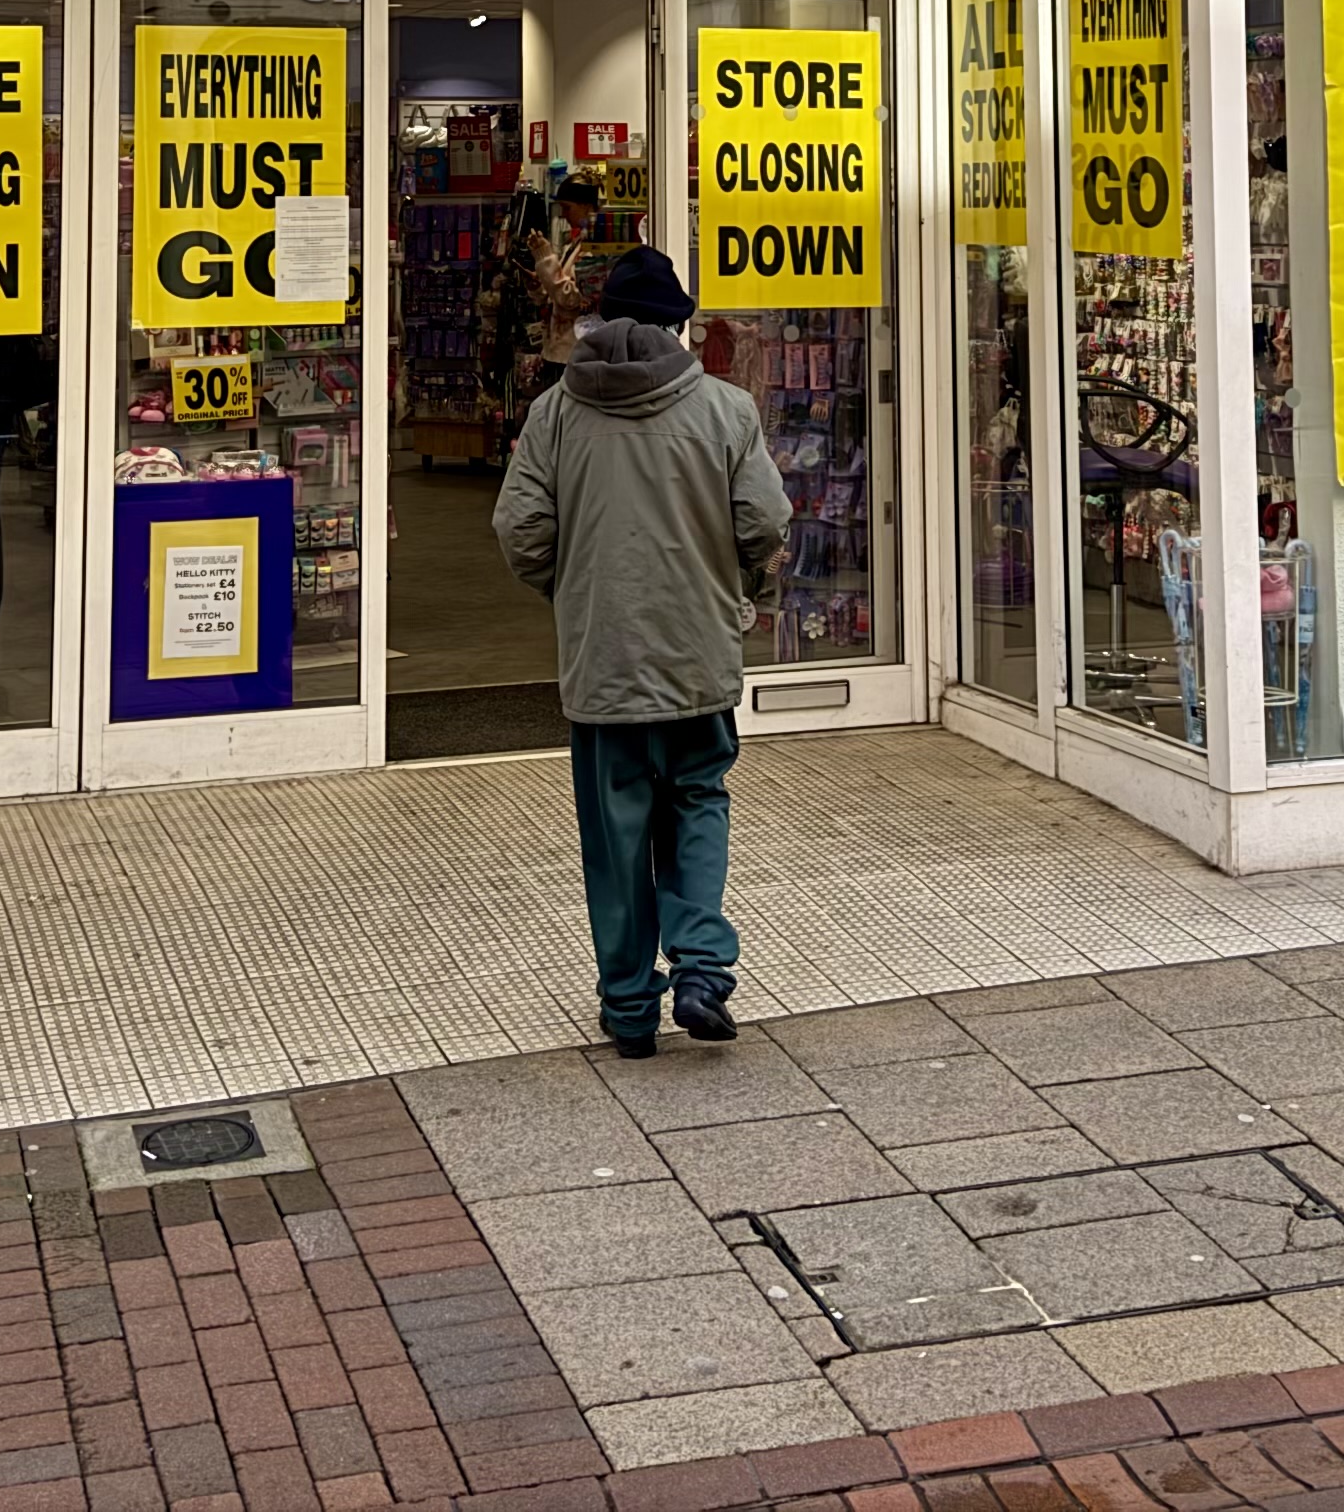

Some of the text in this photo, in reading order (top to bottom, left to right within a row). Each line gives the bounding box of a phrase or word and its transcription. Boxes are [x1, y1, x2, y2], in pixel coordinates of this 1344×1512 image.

[160, 53, 322, 120] EVERYTHING
[715, 59, 864, 110] STORE
[1082, 62, 1169, 136] MUST
[449, 122, 489, 136] SALE
[587, 124, 616, 134] SALE
[159, 141, 323, 209] MUST
[715, 141, 864, 194] CLOSING
[613, 167, 647, 199] 30
[1082, 154, 1170, 229] GO
[717, 225, 864, 277] DOWN
[231, 391, 248, 406] OFF
[177, 408, 250, 421] ORIGINAL PRICE
[176, 568, 236, 578] HELLO KITTY
[219, 578, 236, 588] £4
[213, 590, 236, 601] £10
[187, 611, 222, 620] STITCH
[195, 621, 235, 633] £2.50
